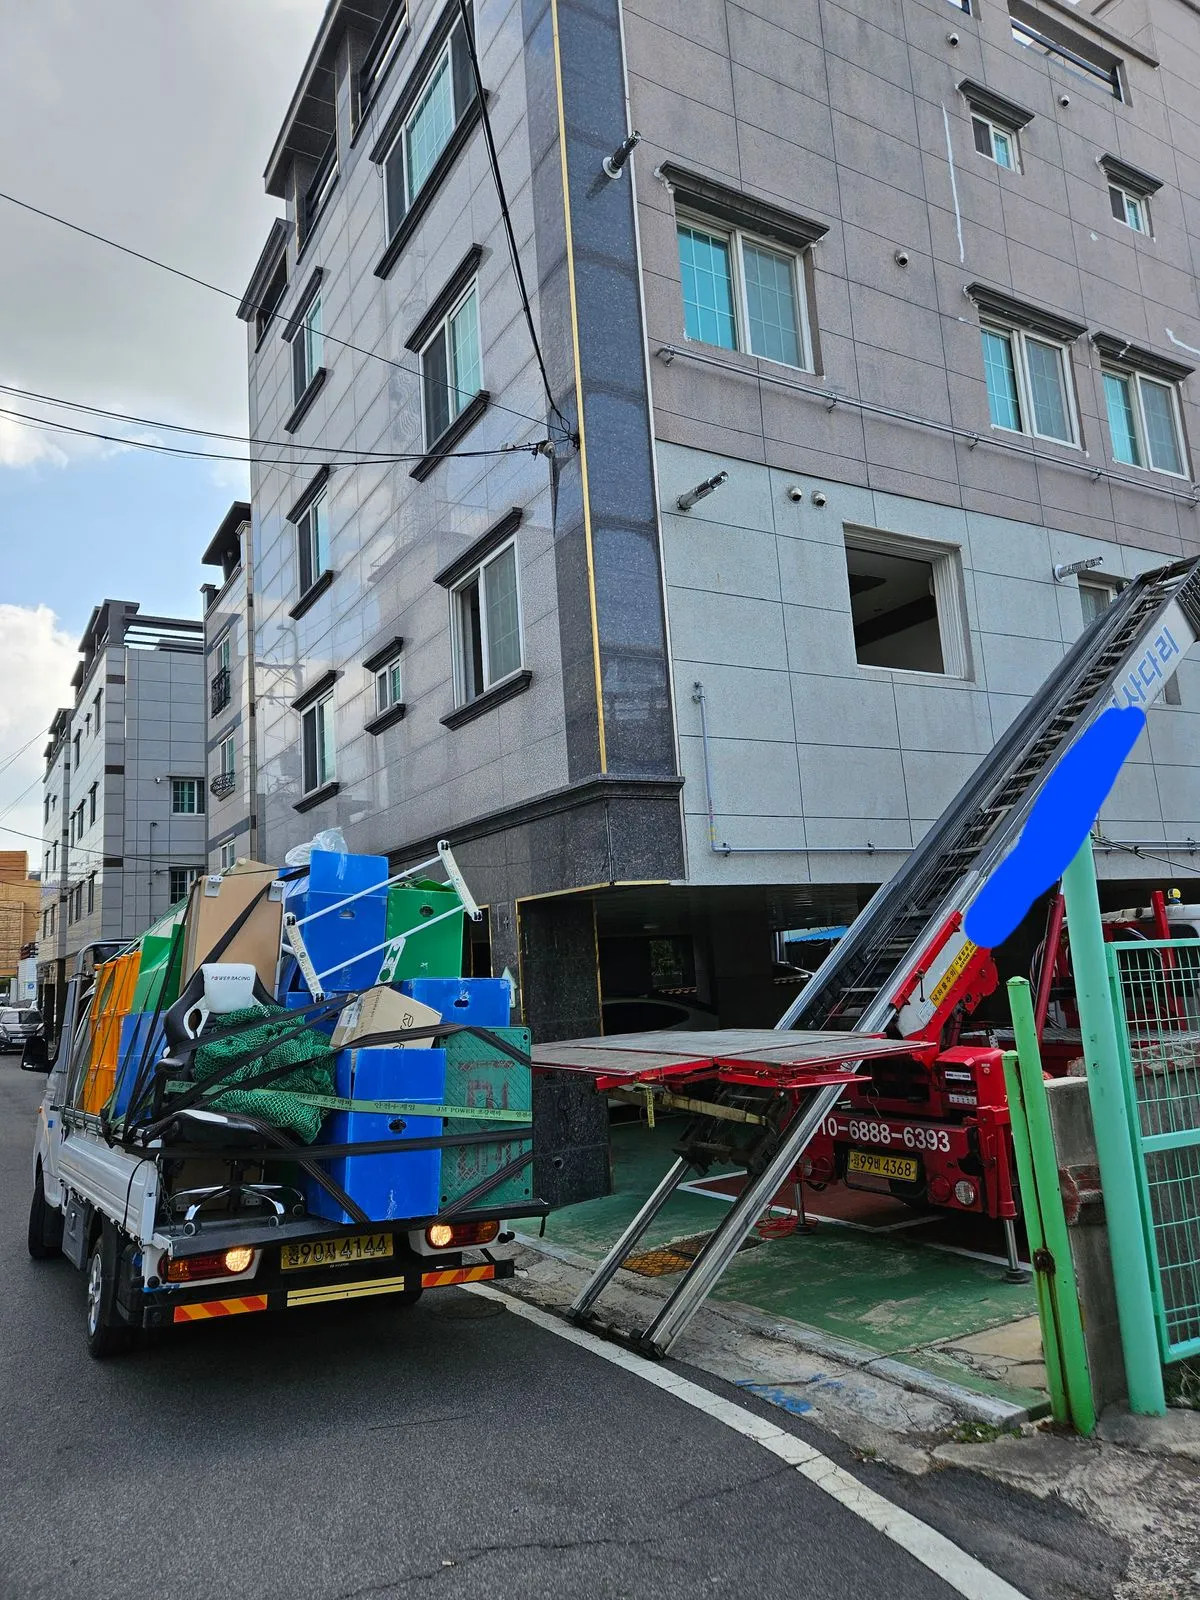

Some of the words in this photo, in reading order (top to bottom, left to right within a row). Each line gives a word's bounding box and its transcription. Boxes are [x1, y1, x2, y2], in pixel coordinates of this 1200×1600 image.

[1112, 624, 1180, 707] 사다리
[450, 1107, 475, 1115] POWER
[814, 1117, 951, 1152] 10-6888-6393
[883, 1158, 912, 1177] 4368
[341, 1235, 386, 1259] 4144
